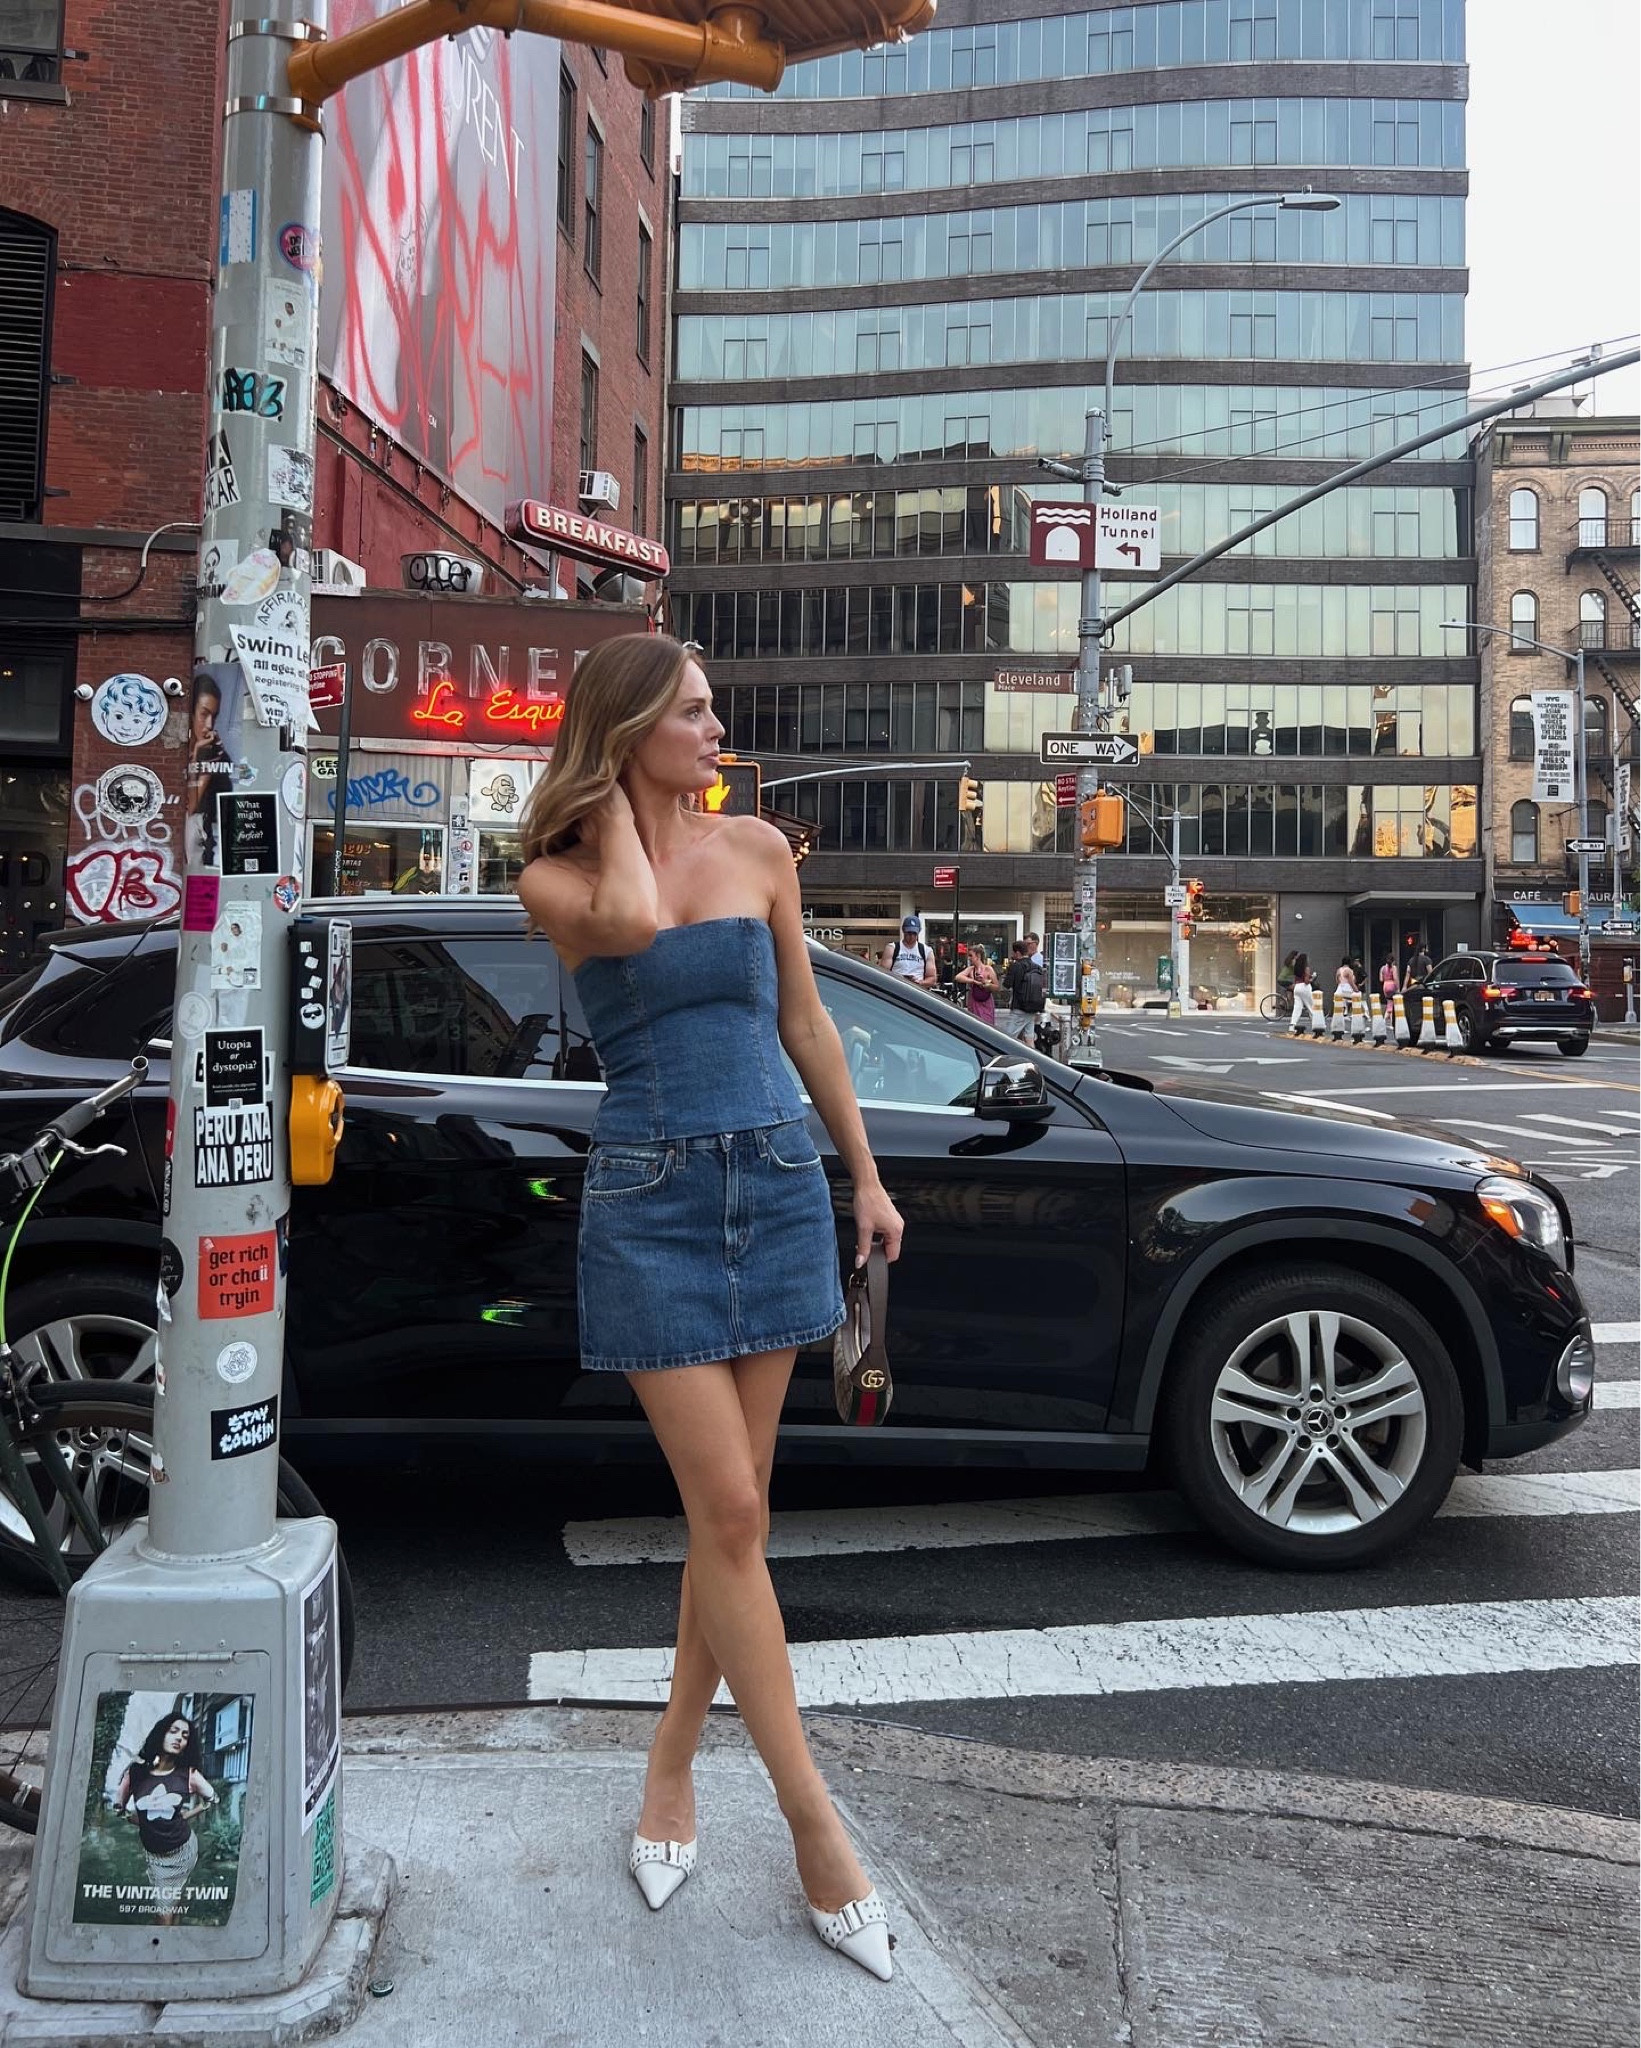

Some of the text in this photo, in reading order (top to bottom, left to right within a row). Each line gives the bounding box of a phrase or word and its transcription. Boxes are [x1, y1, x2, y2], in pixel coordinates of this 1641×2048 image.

[1101, 507, 1157, 522] Holland
[536, 507, 663, 565] BREAKFAST
[1101, 525, 1155, 540] Tunnel
[998, 673, 1061, 686] Cleveland
[413, 683, 565, 730] La Esqui
[1050, 742, 1126, 756] ONE WAY
[202, 762, 234, 773] TWIN
[237, 801, 260, 809] What
[237, 810, 262, 820] might
[217, 1040, 252, 1051] Utopia
[212, 1060, 257, 1074] dystopia?
[196, 1106, 271, 1146] PERU ANA
[197, 1142, 272, 1184] ANA PERU
[209, 1245, 268, 1270] get rich
[210, 1265, 268, 1286] or chaii
[220, 1287, 260, 1310] tryin
[228, 1405, 269, 1433] STAY
[219, 1418, 274, 1454] COOKIN
[83, 1884, 229, 1900] THE VINTAGE TWIN
[119, 1905, 190, 1914] 597 BROADWAY
